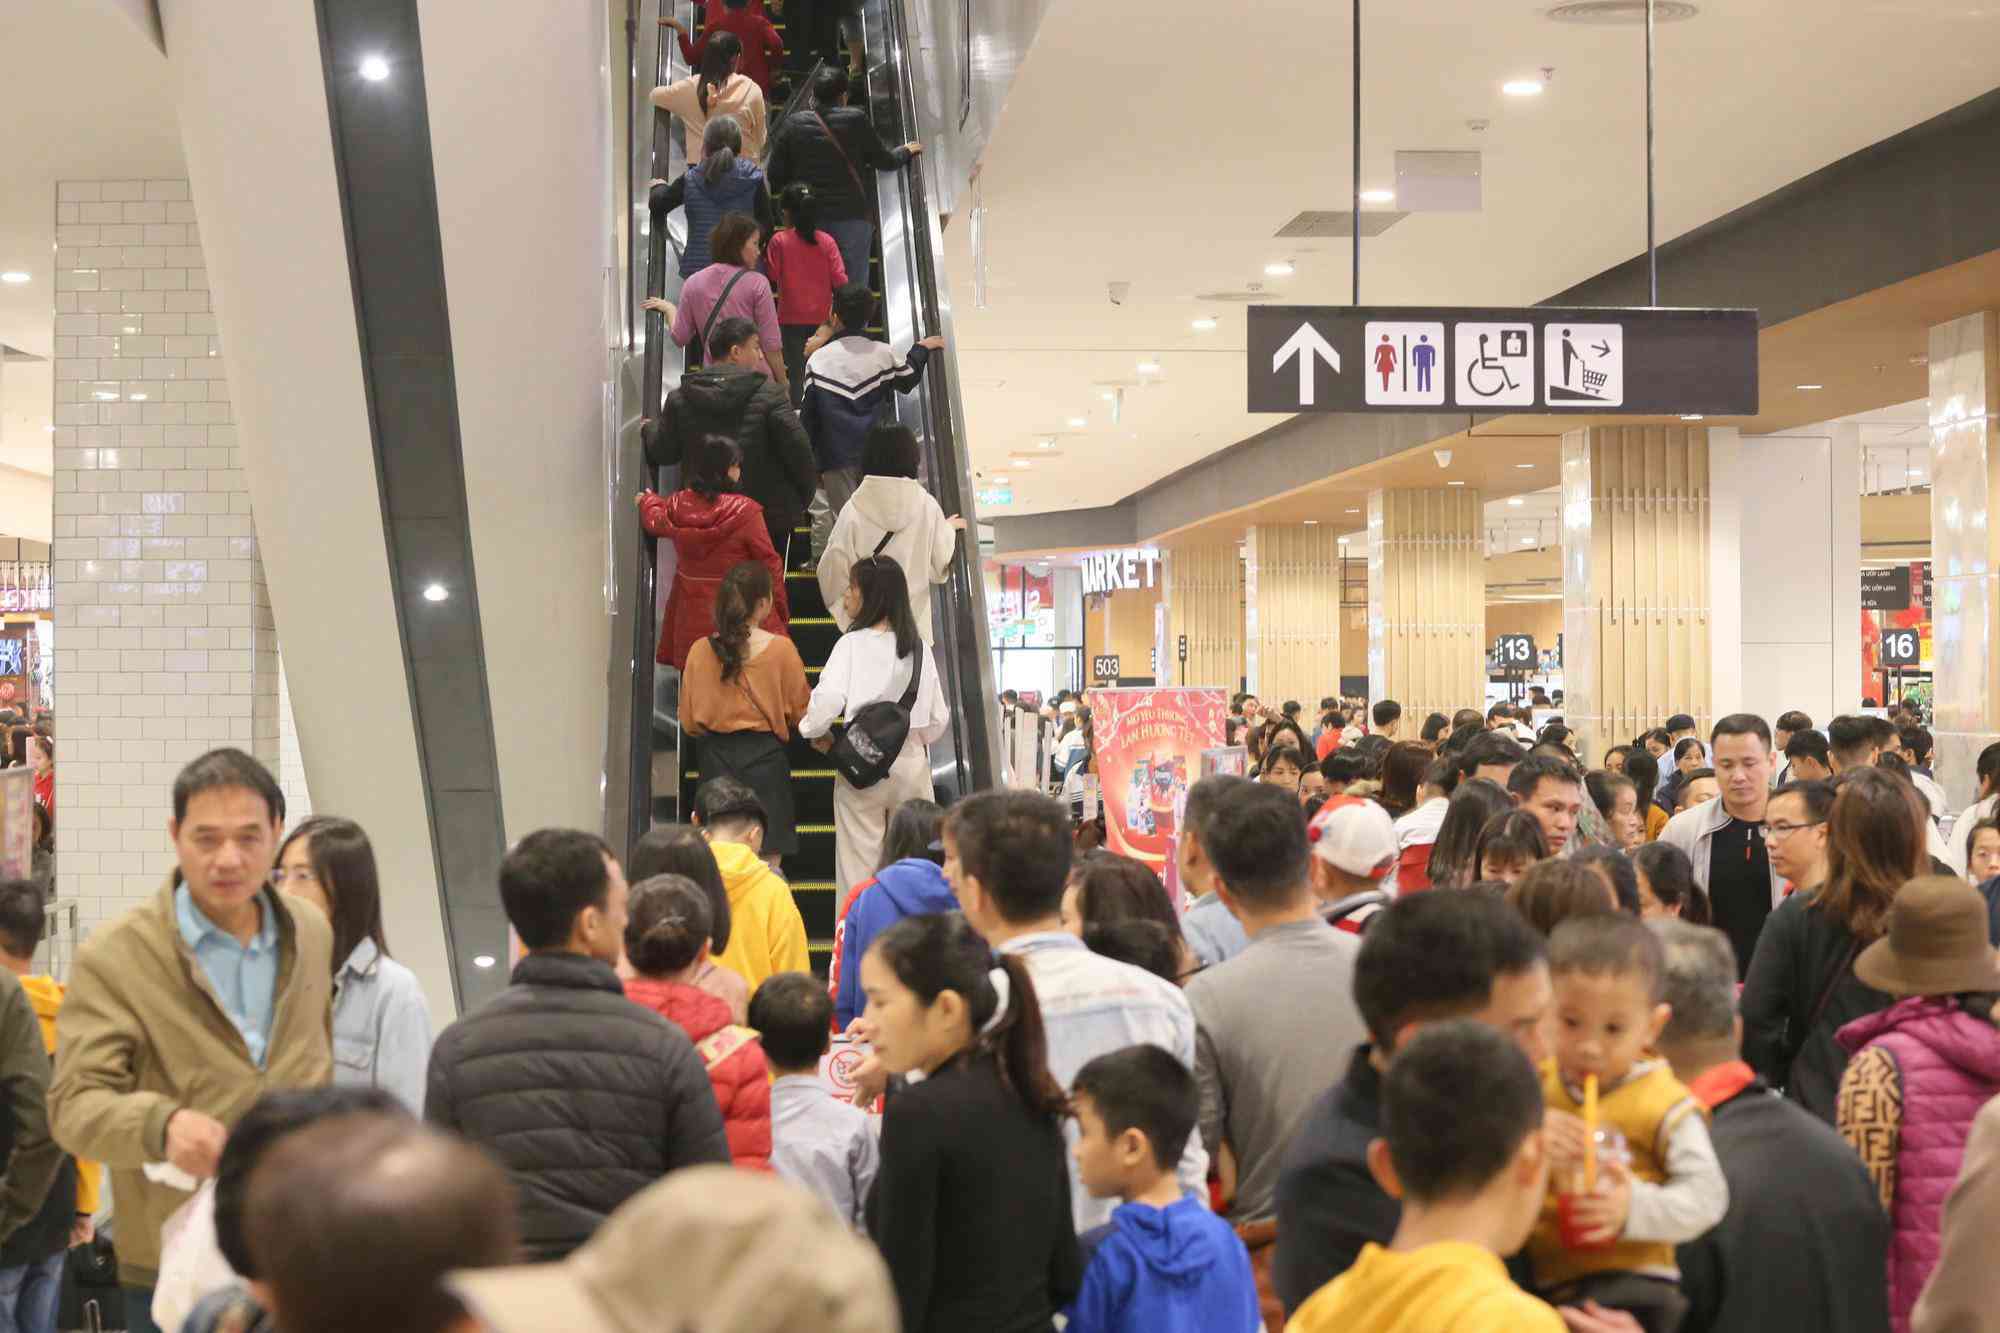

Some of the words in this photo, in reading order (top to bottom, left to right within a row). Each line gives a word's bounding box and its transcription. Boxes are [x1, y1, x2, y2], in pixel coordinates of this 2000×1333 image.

[1505, 638, 1530, 661] 13
[1885, 633, 1914, 658] 16
[1095, 658, 1119, 676] 503
